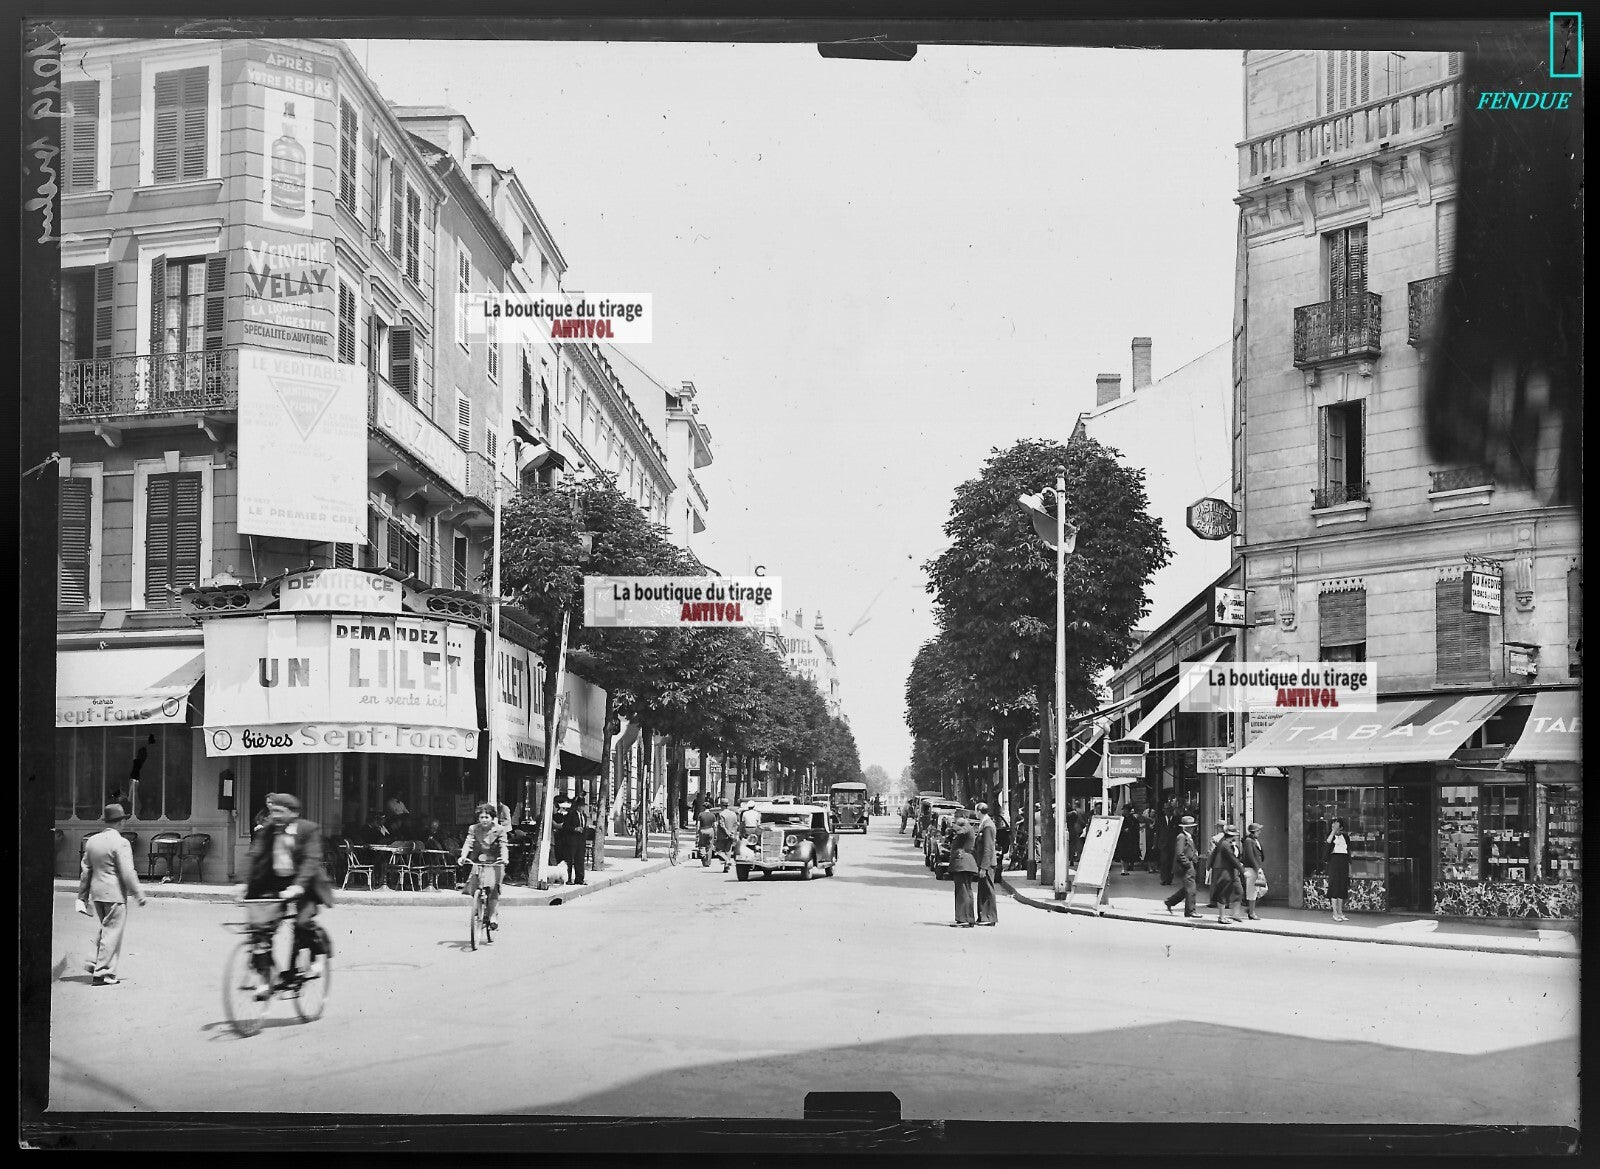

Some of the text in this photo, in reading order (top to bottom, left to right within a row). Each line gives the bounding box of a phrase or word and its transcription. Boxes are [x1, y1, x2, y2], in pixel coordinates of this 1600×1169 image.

[247, 68, 332, 98] VOTRE REPAS
[244, 240, 327, 274] VERVEINE
[247, 263, 328, 299] VELAY
[251, 303, 265, 316] LA
[276, 314, 328, 333] DIGESTIVE
[252, 356, 266, 370] LE
[249, 505, 264, 515] LE
[270, 507, 327, 521] PREMIER
[1196, 501, 1232, 519] PASTILLES
[1203, 514, 1221, 524] VICHY
[1196, 520, 1231, 536] CENTRALE
[287, 574, 394, 593] DENTIFRICE
[1472, 576, 1480, 586] AU
[305, 593, 386, 608] VICHY
[337, 624, 439, 645] DEMANDEZ
[783, 639, 813, 654] HOTEL
[258, 657, 310, 688] UN
[359, 694, 445, 708] en vente ici
[241, 728, 294, 749] bières
[1286, 720, 1460, 742] TABAC
